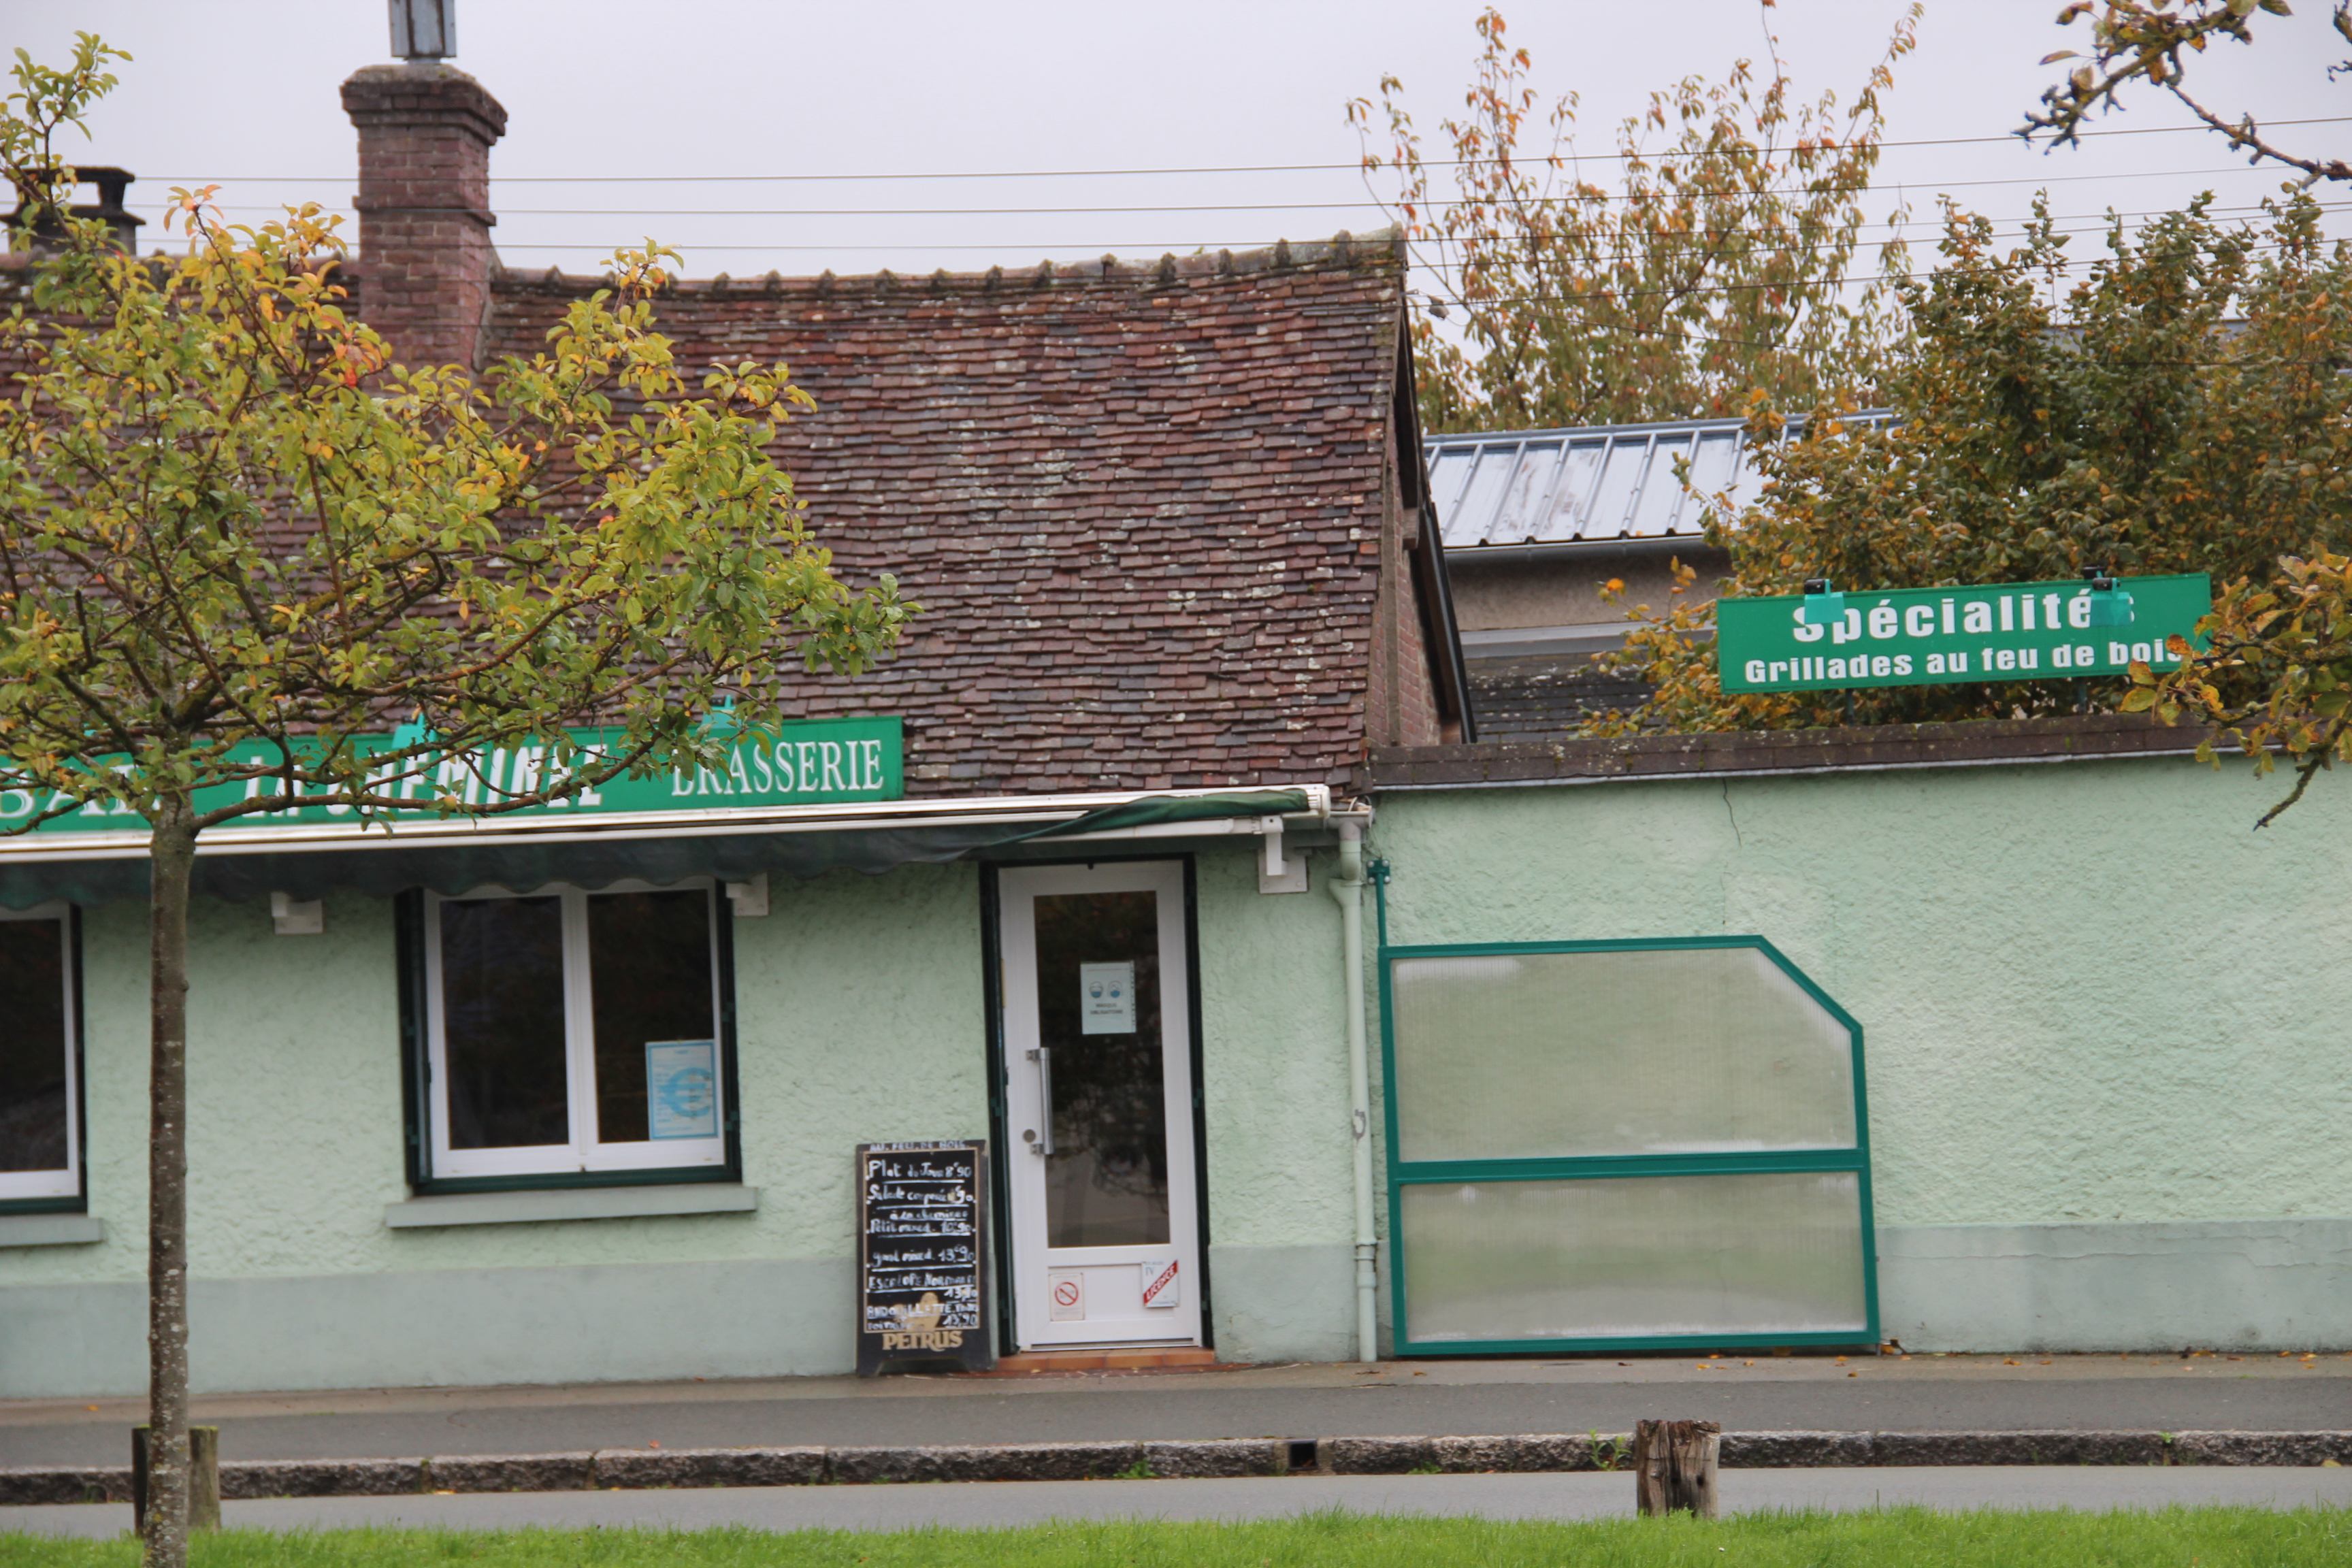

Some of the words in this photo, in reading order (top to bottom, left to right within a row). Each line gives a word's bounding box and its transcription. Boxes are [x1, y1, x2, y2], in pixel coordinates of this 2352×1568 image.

[1793, 588, 2135, 644] Spécialité
[1745, 654, 1913, 683] Grillades
[1926, 652, 1968, 674] au
[1981, 647, 2038, 671] feu
[2053, 644, 2095, 668] de
[868, 1159, 902, 1179] Plat
[1145, 1264, 1176, 1300] LICENCE
[882, 1330, 964, 1352] PETRUS
